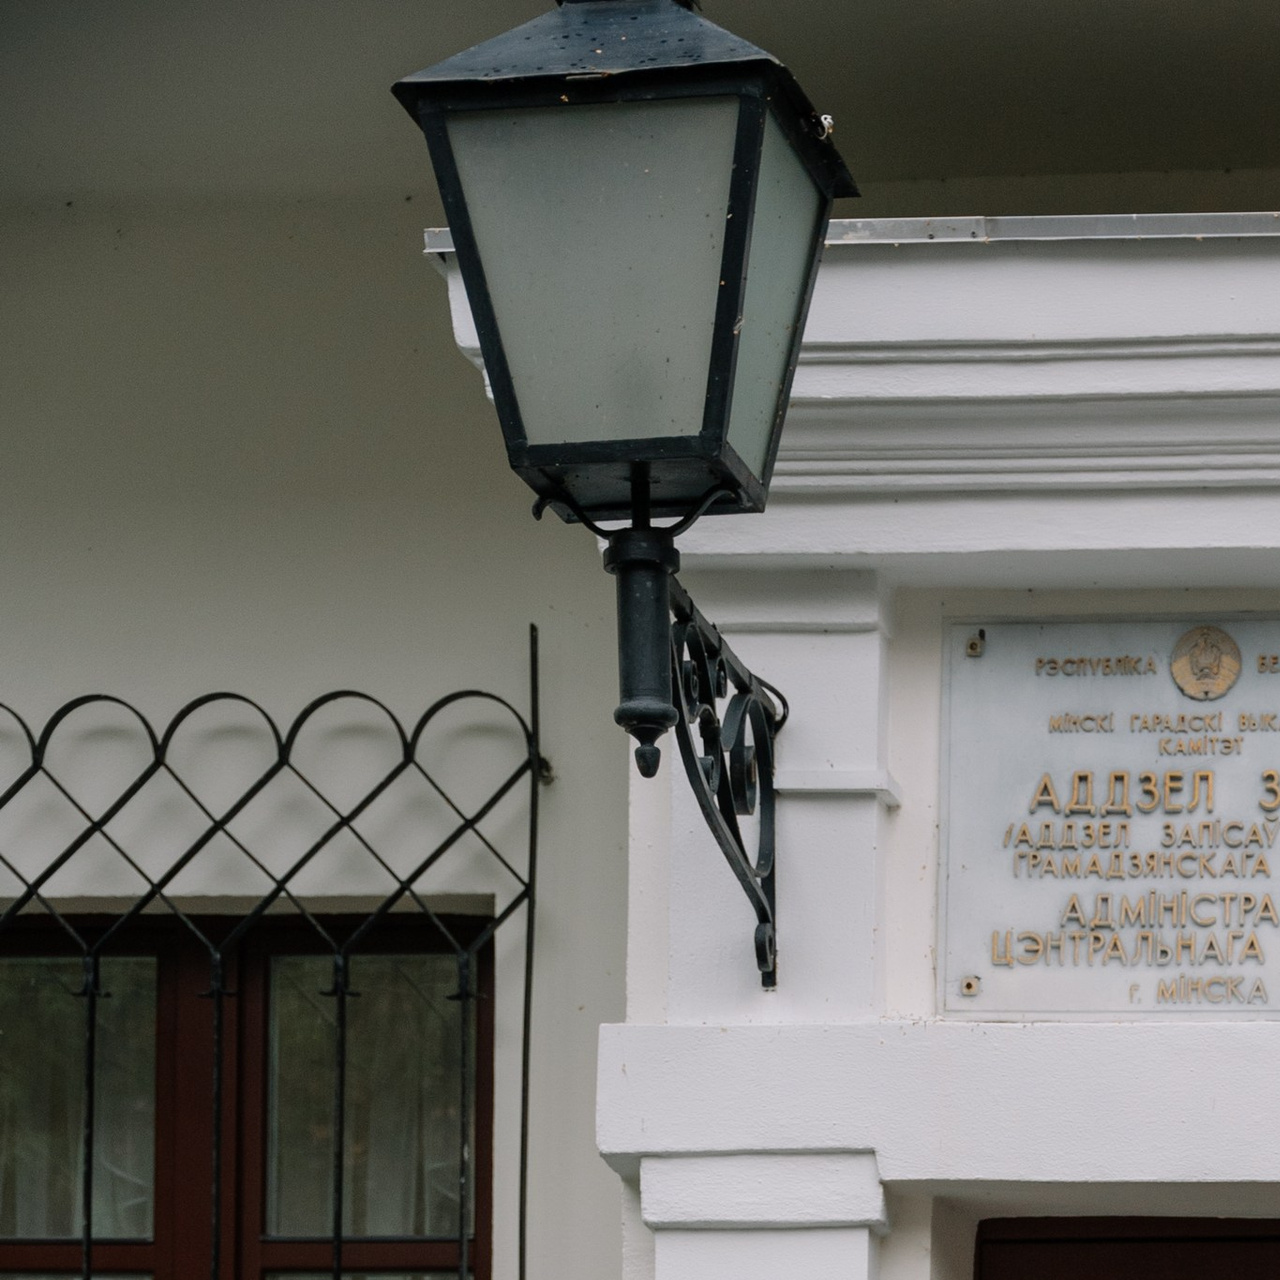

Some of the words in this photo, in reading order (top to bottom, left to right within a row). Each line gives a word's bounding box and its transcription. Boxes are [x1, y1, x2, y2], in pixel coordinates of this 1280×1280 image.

[1035, 655, 1157, 677] РЭСПУБЛІКА
[1049, 711, 1114, 733] МІНСКІ
[1130, 711, 1222, 733] ГАРАДСКІ
[1159, 735, 1244, 756] КАМІТЭТ
[1029, 769, 1216, 817] АДДЗЕЛ
[1161, 814, 1280, 848] ЗАПІСАЎ
[1014, 851, 1272, 879] ГРАМАДЗЯНСКАГА
[991, 929, 1265, 968] ЦЭНТРАЛЬНАГА
[1157, 974, 1268, 1004] МІНСКА
